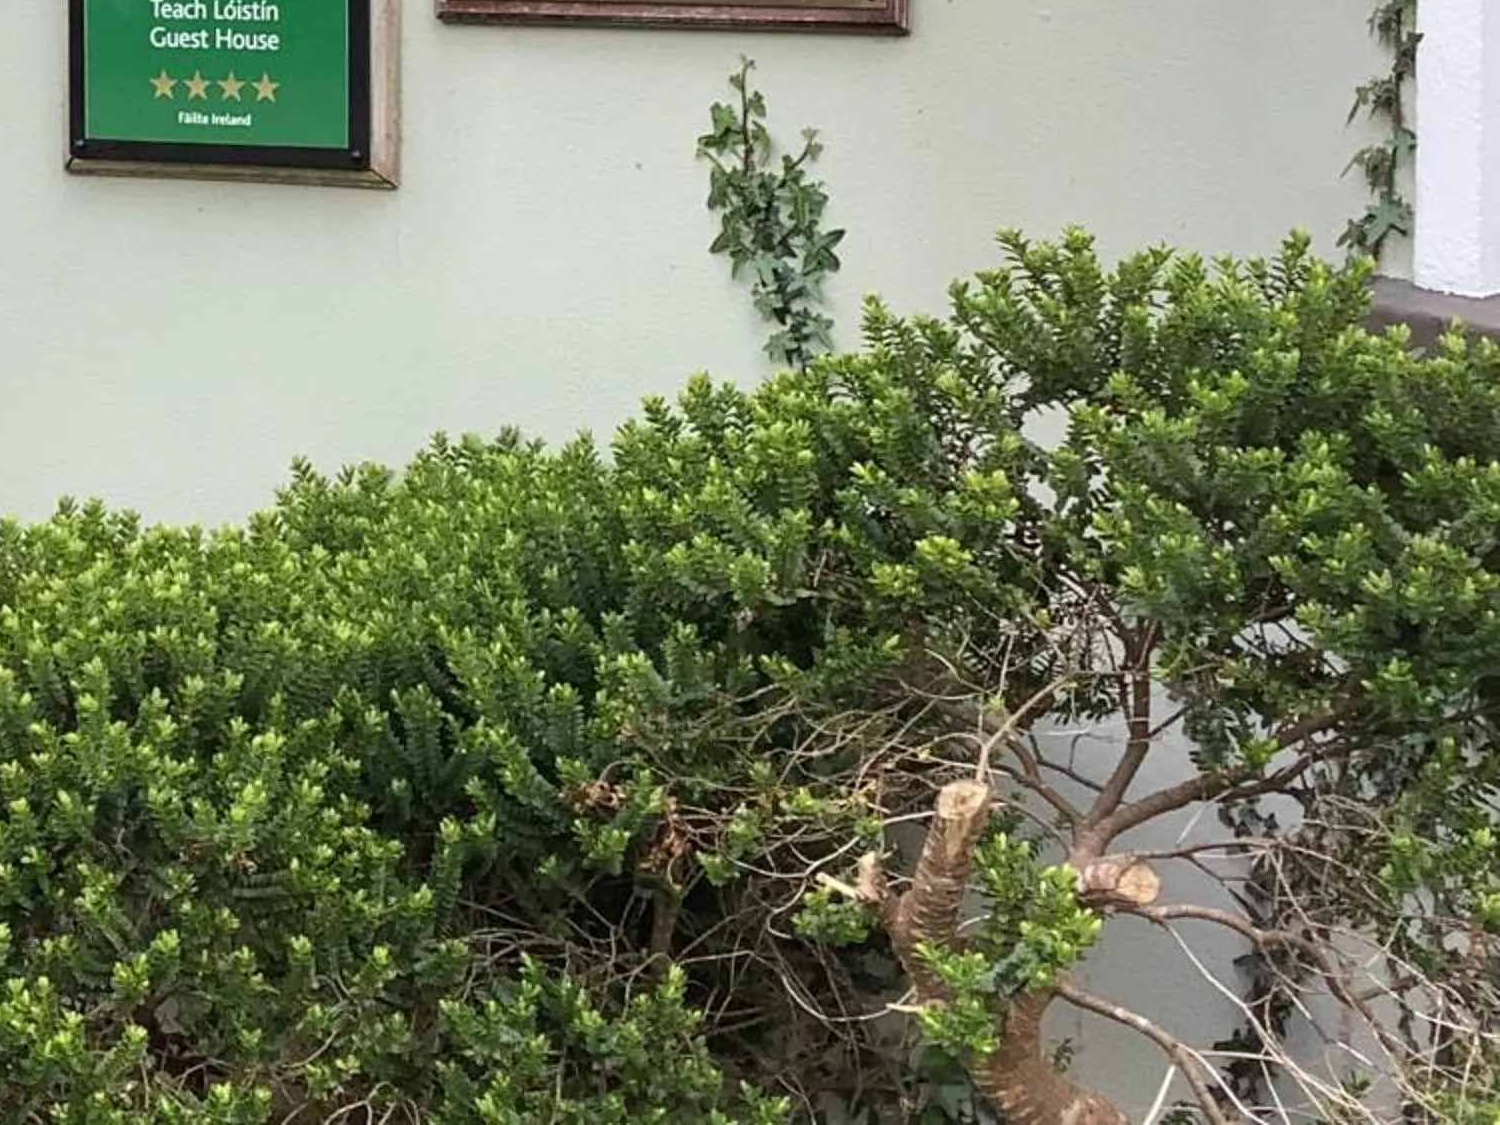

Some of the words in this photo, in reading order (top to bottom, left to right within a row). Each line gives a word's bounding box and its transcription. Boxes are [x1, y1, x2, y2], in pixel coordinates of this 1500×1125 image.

[149, 27, 209, 49] Guest
[215, 28, 280, 51] House
[177, 110, 208, 125] Fáilte
[212, 111, 252, 127] Ireland
